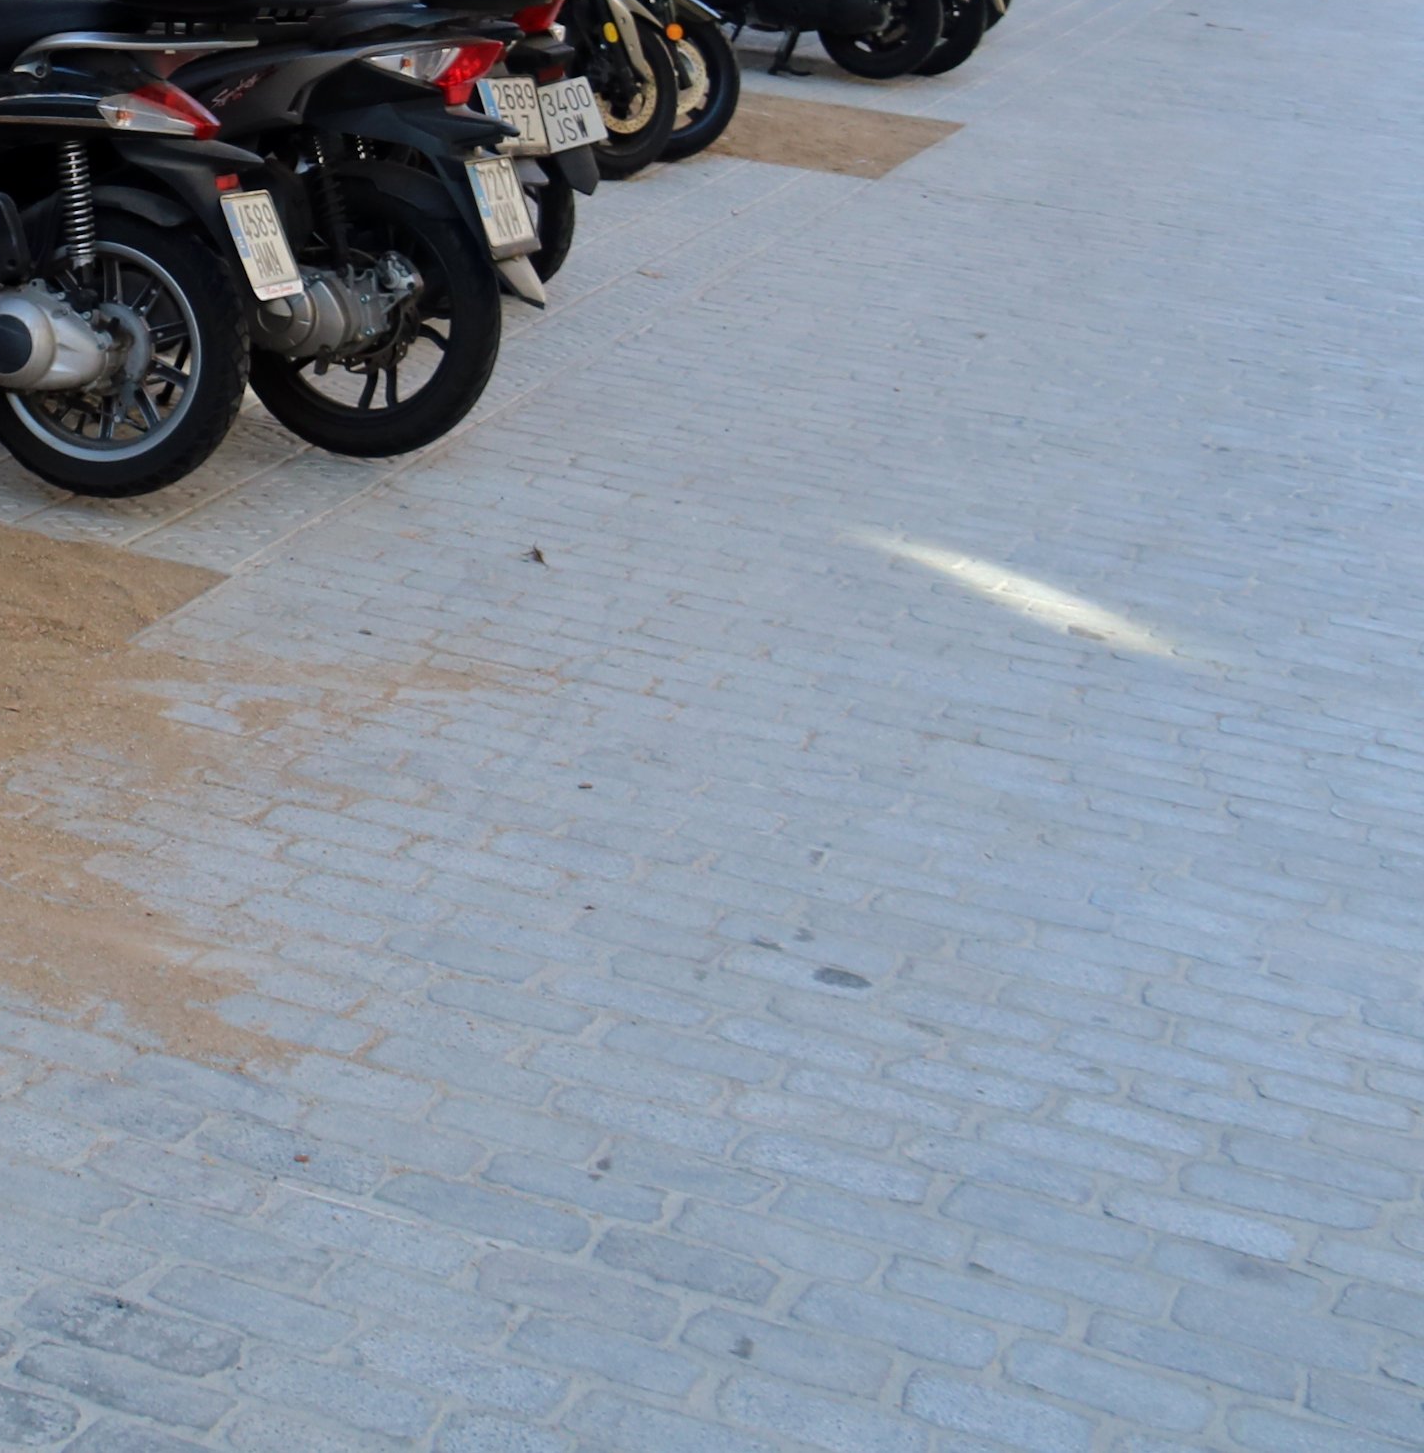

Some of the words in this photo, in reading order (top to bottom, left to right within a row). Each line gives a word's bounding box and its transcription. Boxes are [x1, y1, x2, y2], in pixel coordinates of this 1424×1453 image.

[491, 82, 537, 111] 2689
[540, 83, 592, 118] 3400
[555, 113, 590, 145] JSW
[237, 202, 279, 239] 4589
